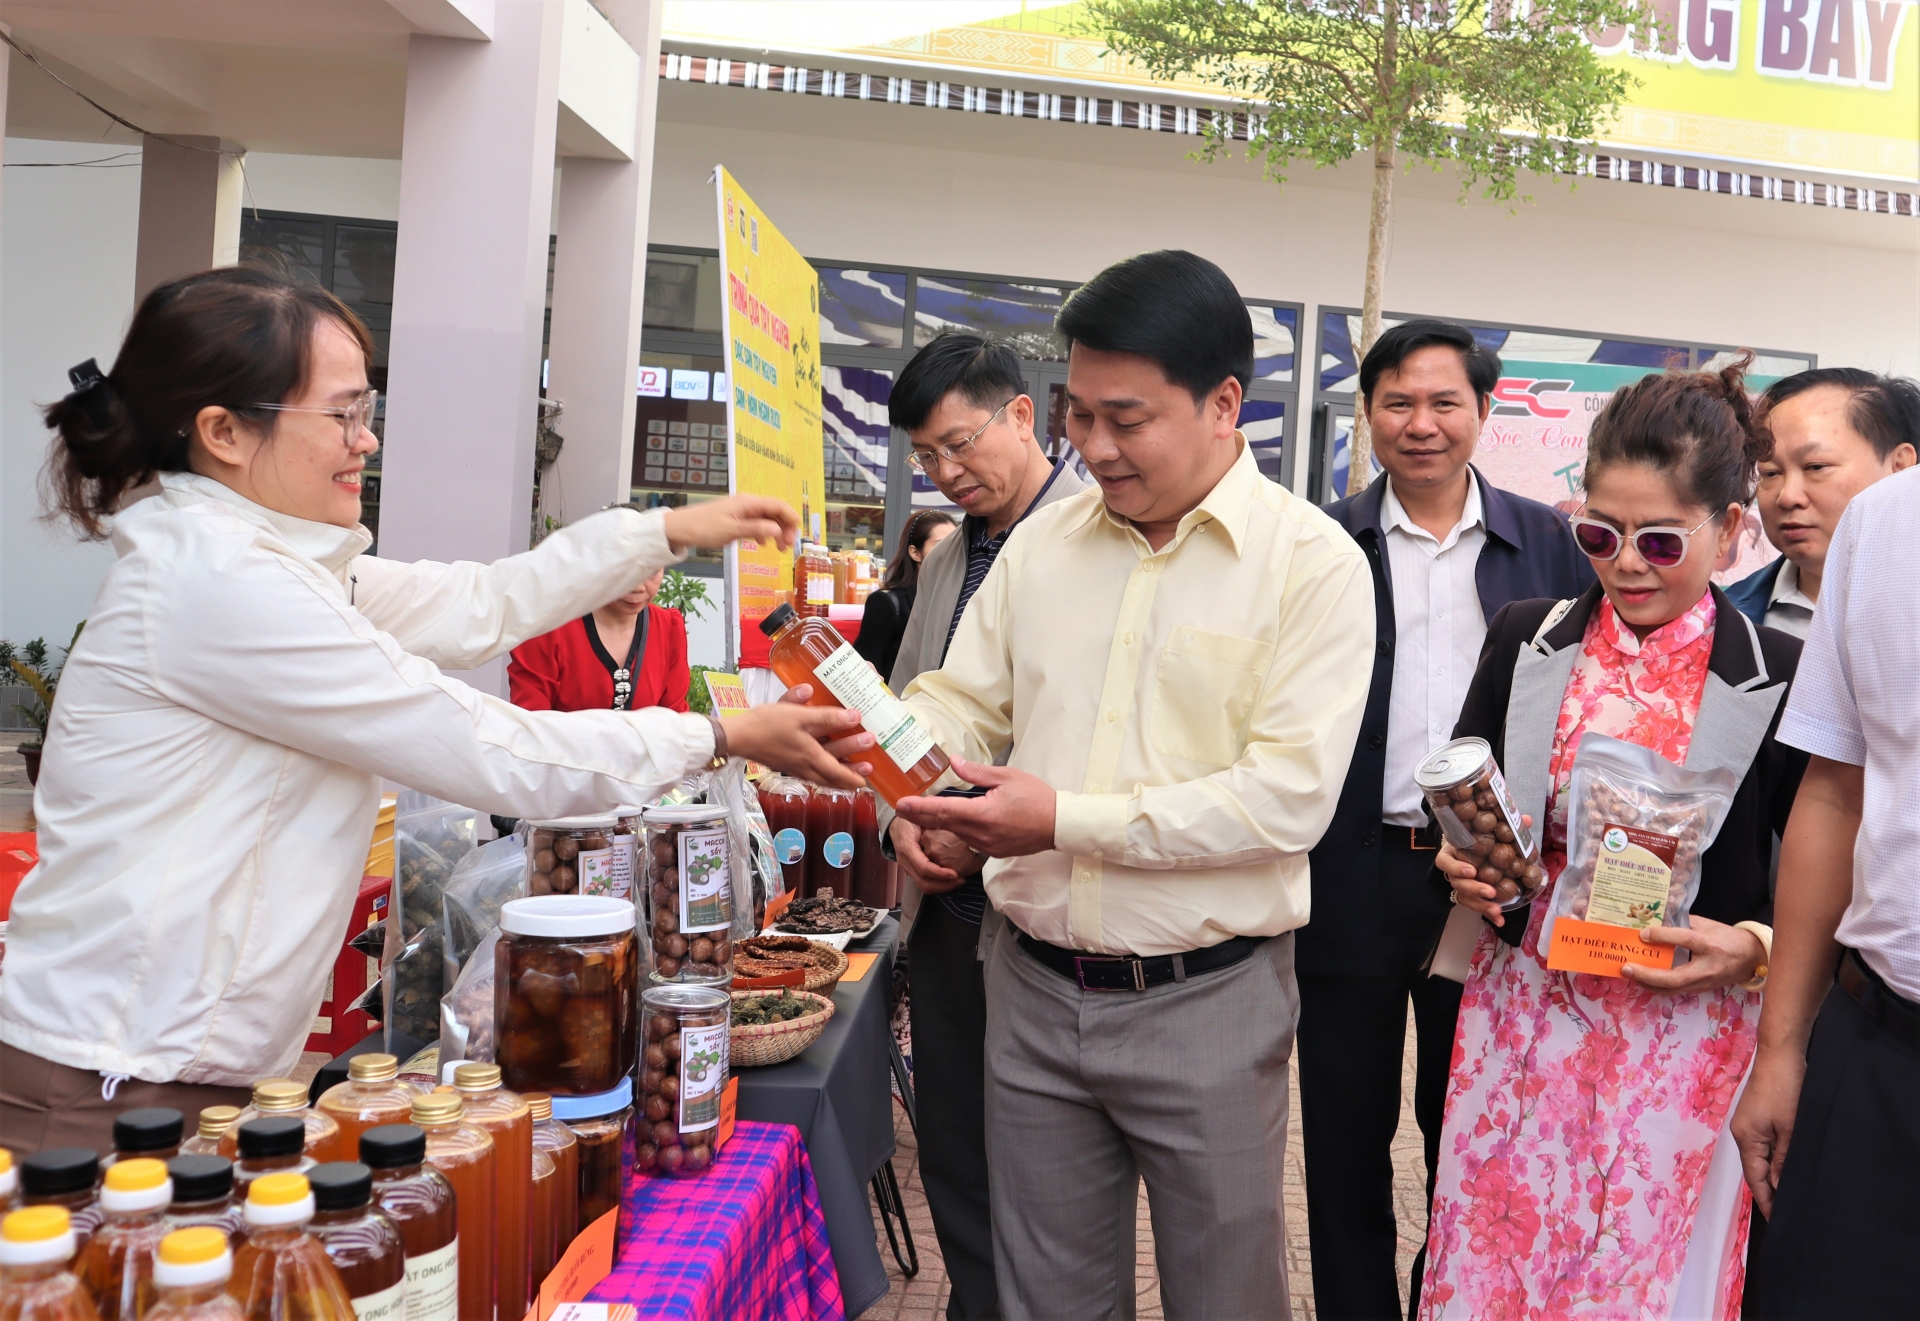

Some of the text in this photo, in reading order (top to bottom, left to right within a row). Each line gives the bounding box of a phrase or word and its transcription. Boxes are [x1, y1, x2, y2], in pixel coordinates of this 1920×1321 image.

[674, 381, 697, 390] BIDV
[823, 664, 838, 678] MẬT
[837, 653, 849, 666] ONG
[705, 838, 724, 847] MACCA
[711, 846, 721, 856] SẤY
[1604, 857, 1618, 865] HẠT
[1620, 860, 1635, 868] ĐIỀU
[1647, 866, 1665, 875] RANG
[1561, 935, 1582, 946] HẠT
[1584, 936, 1608, 949] ĐIỀU
[1611, 942, 1639, 955] RANG
[710, 1040, 720, 1051] SẤY
[422, 1263, 443, 1278] ONG
[444, 1255, 456, 1269] HO
[365, 1305, 388, 1321] ONG
[391, 1296, 402, 1310] HO
